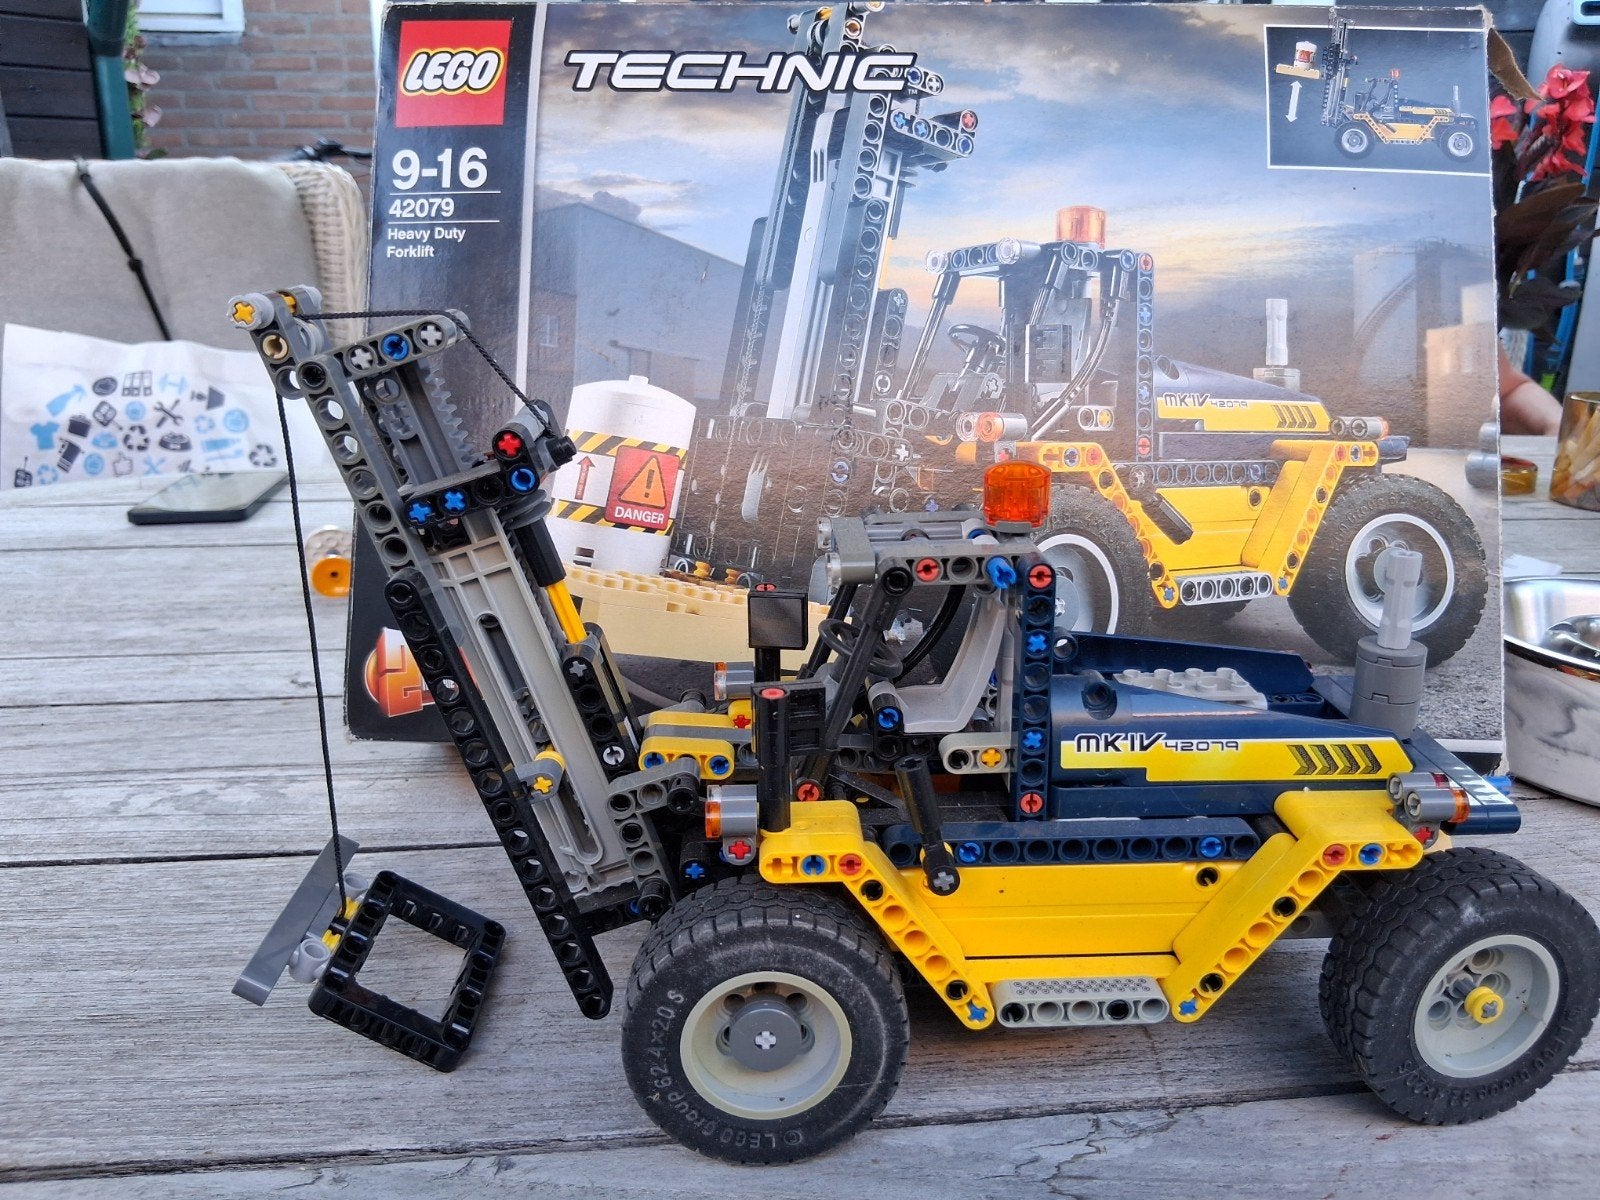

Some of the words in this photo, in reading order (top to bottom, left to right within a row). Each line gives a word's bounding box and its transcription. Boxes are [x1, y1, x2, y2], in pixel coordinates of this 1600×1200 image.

[402, 49, 502, 94] LEGO
[565, 52, 918, 91] TECHNIC
[392, 147, 488, 190] 9-16
[388, 198, 455, 218] 42079
[387, 228, 430, 243] Heavy
[434, 227, 466, 243] Duty
[386, 245, 435, 258] Forklift
[1210, 400, 1249, 408] 42079
[614, 506, 665, 525] DANGER
[1164, 740, 1239, 752] 42079
[667, 1090, 718, 1136] Group
[719, 1127, 777, 1150] LEGO
